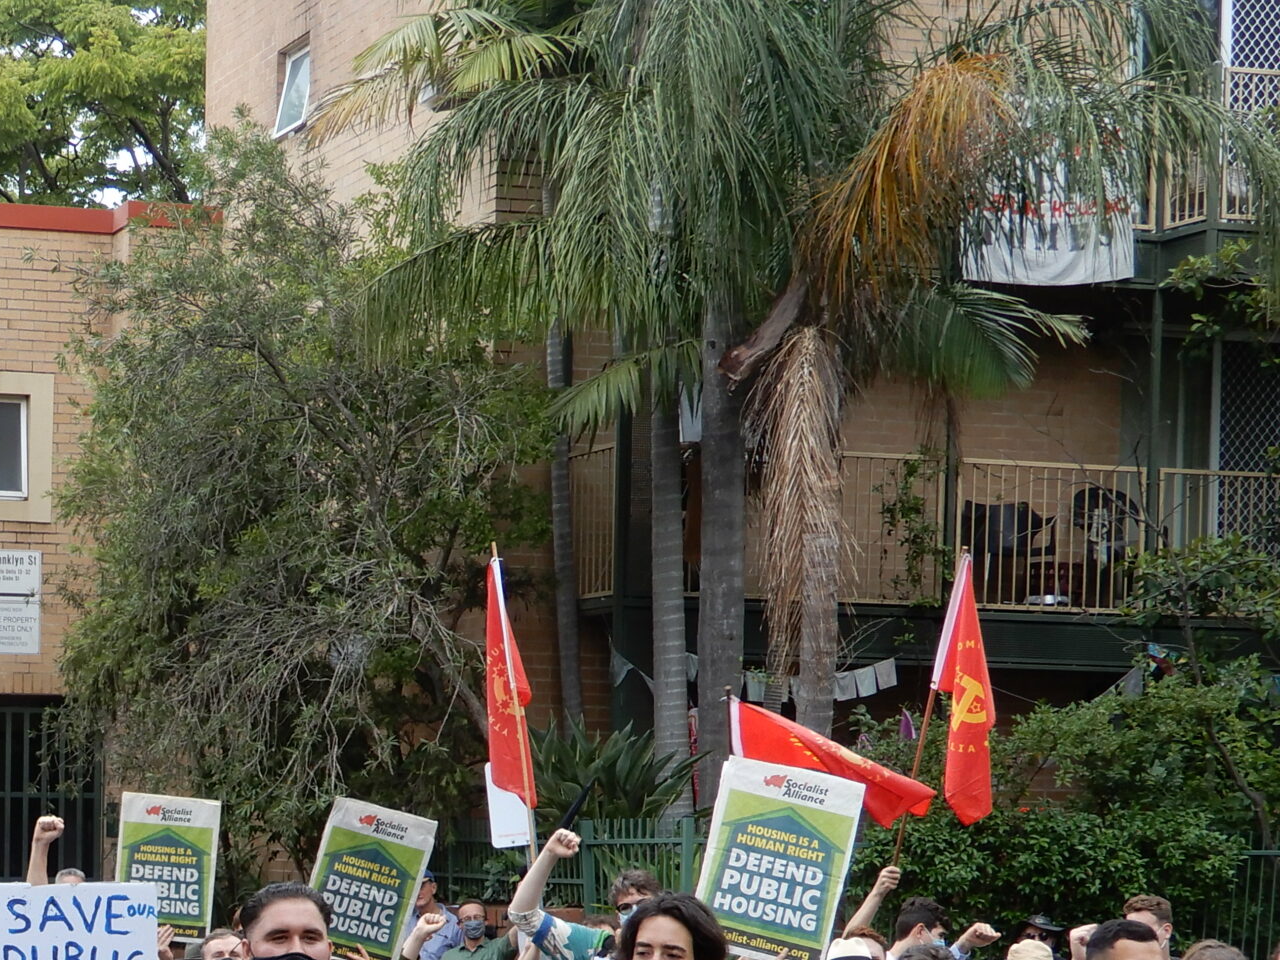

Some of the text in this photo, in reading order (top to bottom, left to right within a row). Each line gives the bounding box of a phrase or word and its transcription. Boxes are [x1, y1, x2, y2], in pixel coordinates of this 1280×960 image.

[28, 555, 37, 566] St
[3, 616, 37, 624] PROPERTY
[784, 778, 829, 796] Socialist
[782, 788, 825, 805] Alliance
[160, 813, 191, 823] Alliance
[161, 807, 193, 816] Socialist
[372, 826, 405, 841] Alliance
[375, 818, 408, 834] Socialist
[747, 823, 819, 849] HOUSING IS A
[140, 844, 192, 856] HOUSING IS A
[736, 833, 826, 862] HUMAN RIGHT
[134, 852, 197, 865] HUMAN RIGHT
[342, 854, 397, 877] HOUSING IS A
[728, 847, 824, 886] DEFEND
[131, 863, 199, 882] DEFEND
[333, 862, 401, 888] HUMAN RIGHT
[326, 874, 399, 907] DEFEND
[721, 868, 821, 911] PUBLIC
[6, 895, 132, 935] SAVE
[127, 904, 158, 918] OUR
[158, 900, 200, 916] SING
[713, 892, 817, 931] HOUSING
